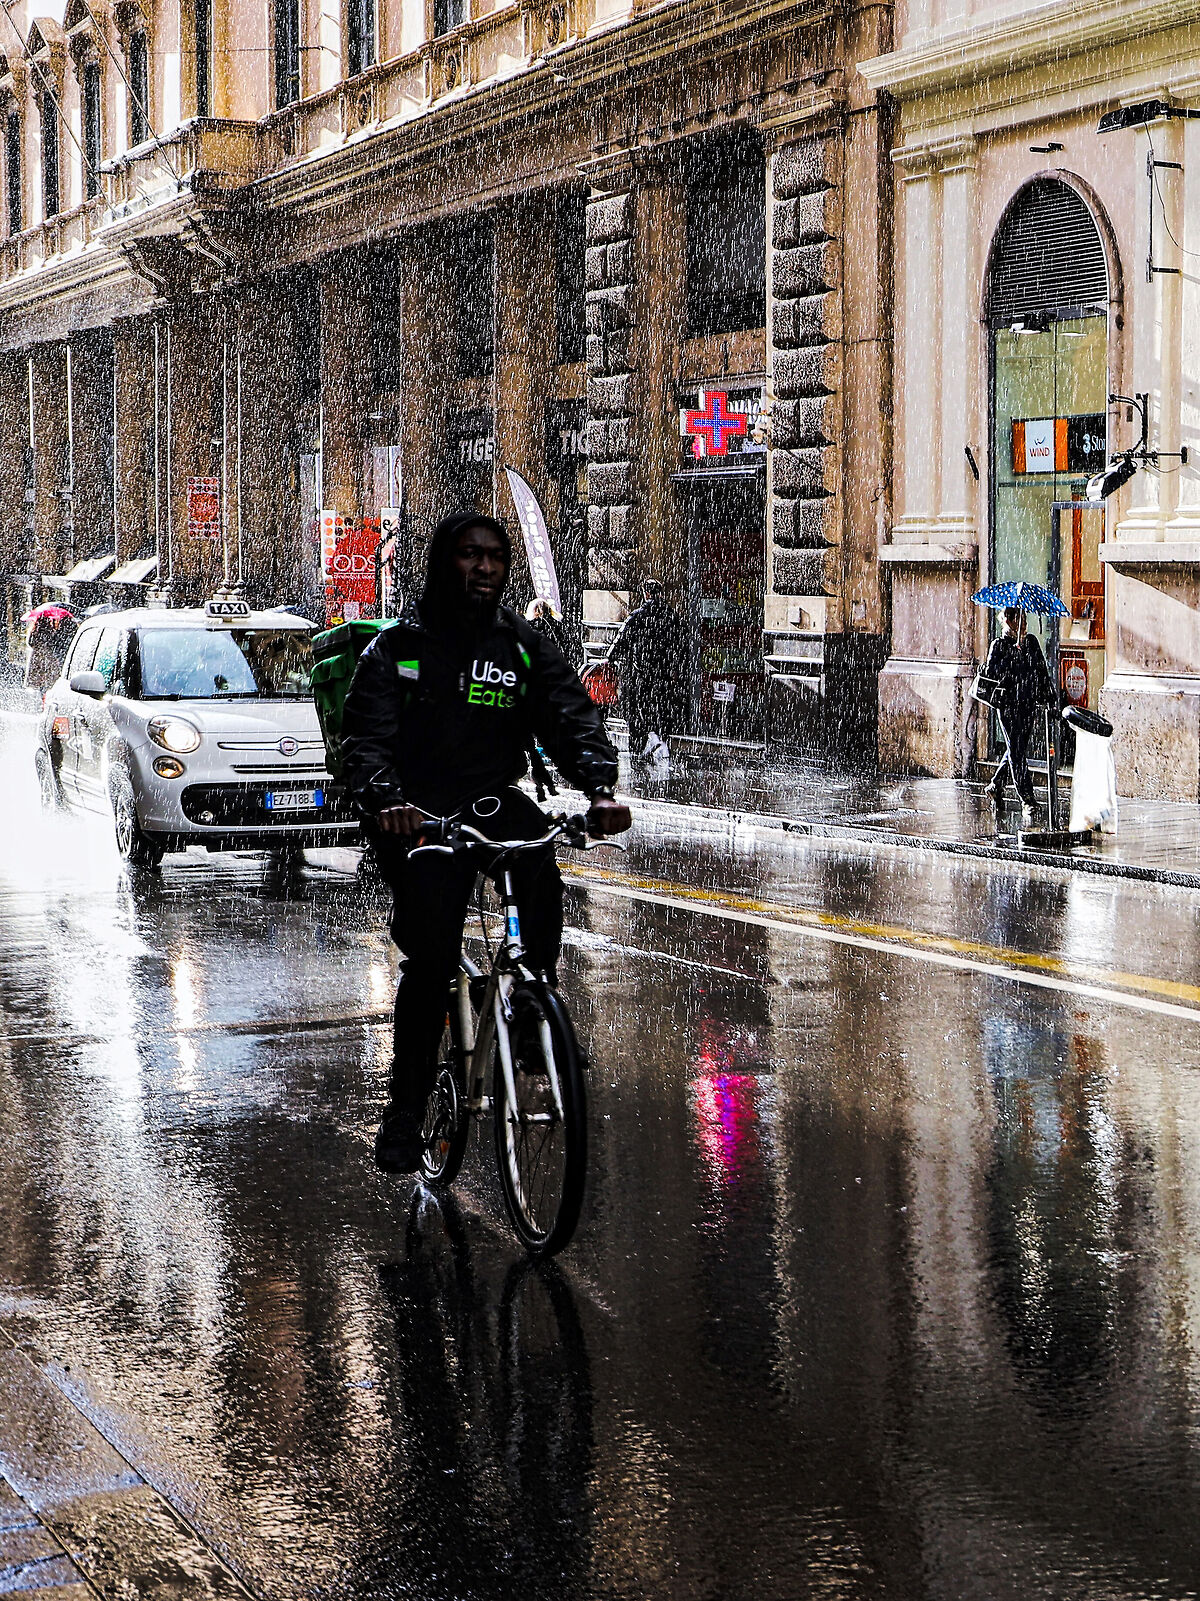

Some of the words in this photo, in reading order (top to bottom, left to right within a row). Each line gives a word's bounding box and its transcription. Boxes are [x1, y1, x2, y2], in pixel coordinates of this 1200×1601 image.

[1029, 446, 1050, 457] WIND
[1082, 433, 1091, 454] 3
[210, 603, 246, 614] TAXI
[467, 683, 516, 708] Eats
